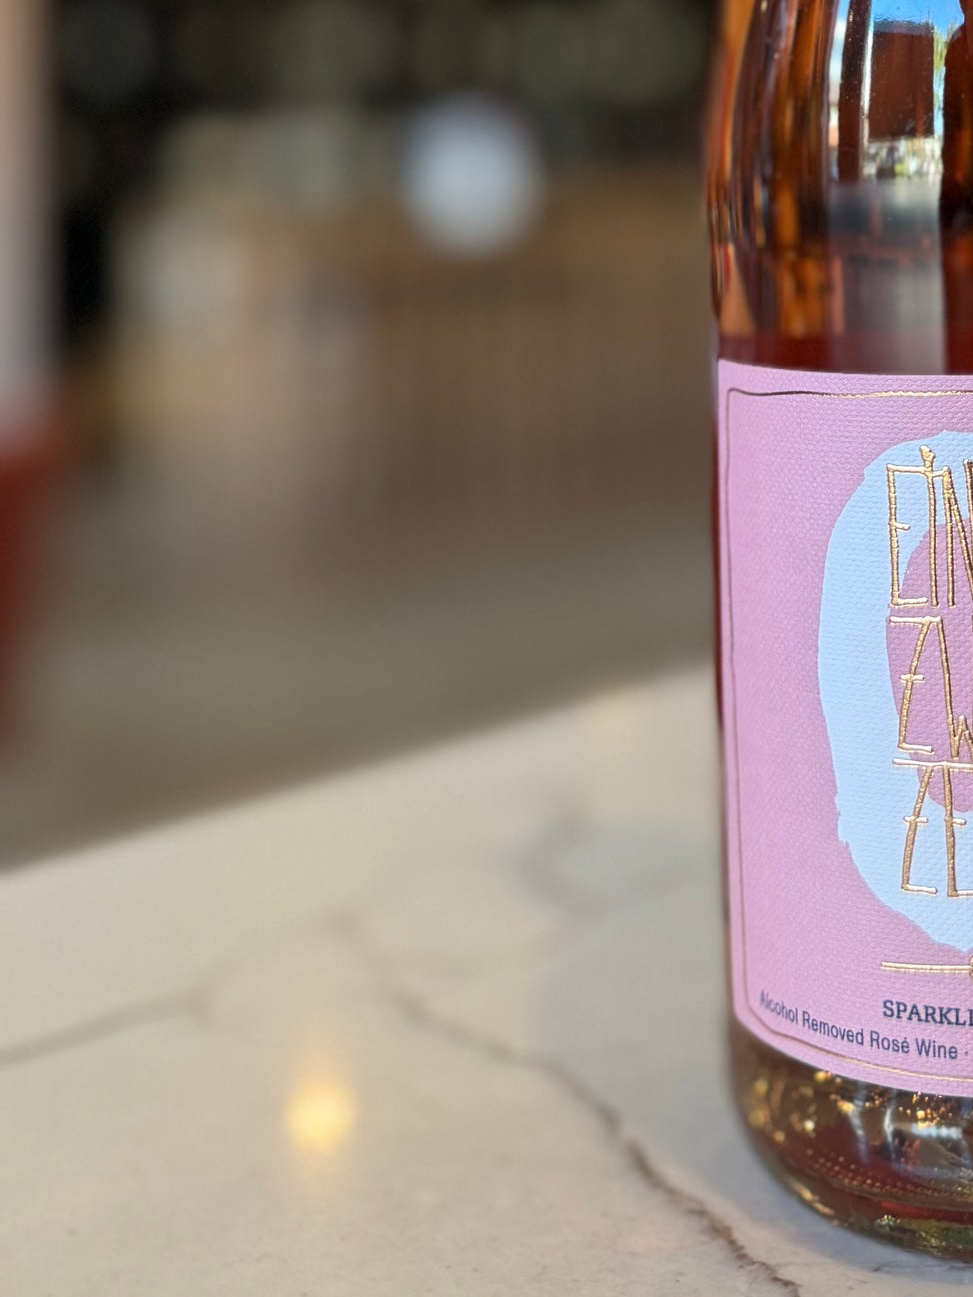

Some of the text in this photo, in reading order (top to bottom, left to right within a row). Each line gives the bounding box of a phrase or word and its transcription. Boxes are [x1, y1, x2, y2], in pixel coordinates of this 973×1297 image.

[759, 990, 799, 1024] Alcohol
[802, 1011, 865, 1046] Removed
[869, 1030, 911, 1054] Rosé
[915, 1038, 958, 1060] Wine
